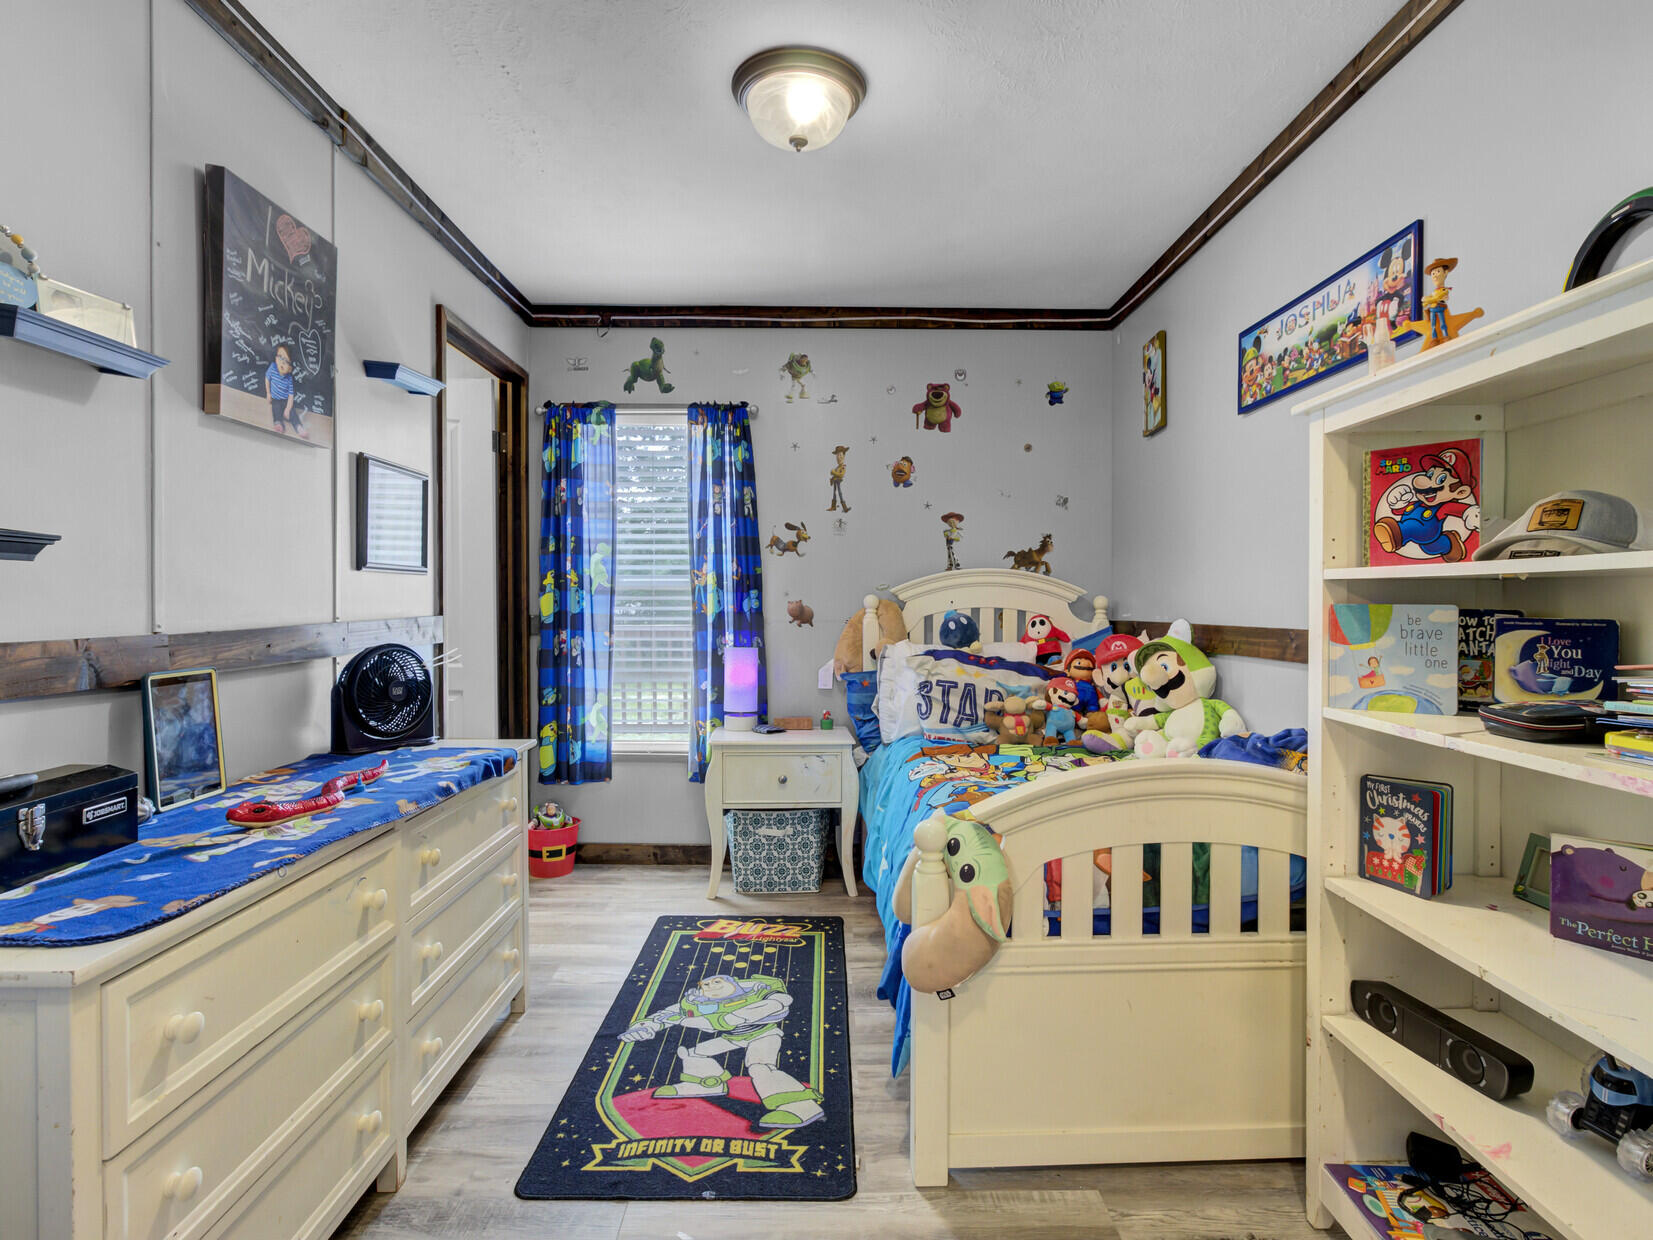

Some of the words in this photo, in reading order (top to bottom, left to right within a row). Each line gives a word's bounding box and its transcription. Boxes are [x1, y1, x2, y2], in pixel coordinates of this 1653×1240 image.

[1276, 279, 1356, 341] JOSHUA
[1375, 463, 1412, 476] MARIO
[1407, 613, 1422, 626] be
[1458, 616, 1478, 626] OW
[1400, 624, 1443, 640] brave
[1458, 625, 1496, 642] ATCH
[1405, 641, 1438, 657] little
[1458, 641, 1495, 657] ANTA
[1548, 636, 1572, 646] Love
[1551, 645, 1582, 659] You
[1425, 658, 1448, 669] one
[1549, 658, 1571, 671] ight
[1573, 665, 1603, 681] Day
[1375, 782, 1391, 794] FIRST
[1366, 789, 1430, 821] Christmas
[1559, 916, 1577, 928] The
[1575, 920, 1639, 949] Perfect
[617, 1138, 696, 1159] INFINITY
[700, 1138, 725, 1153] OR
[729, 1139, 779, 1160] BUST
